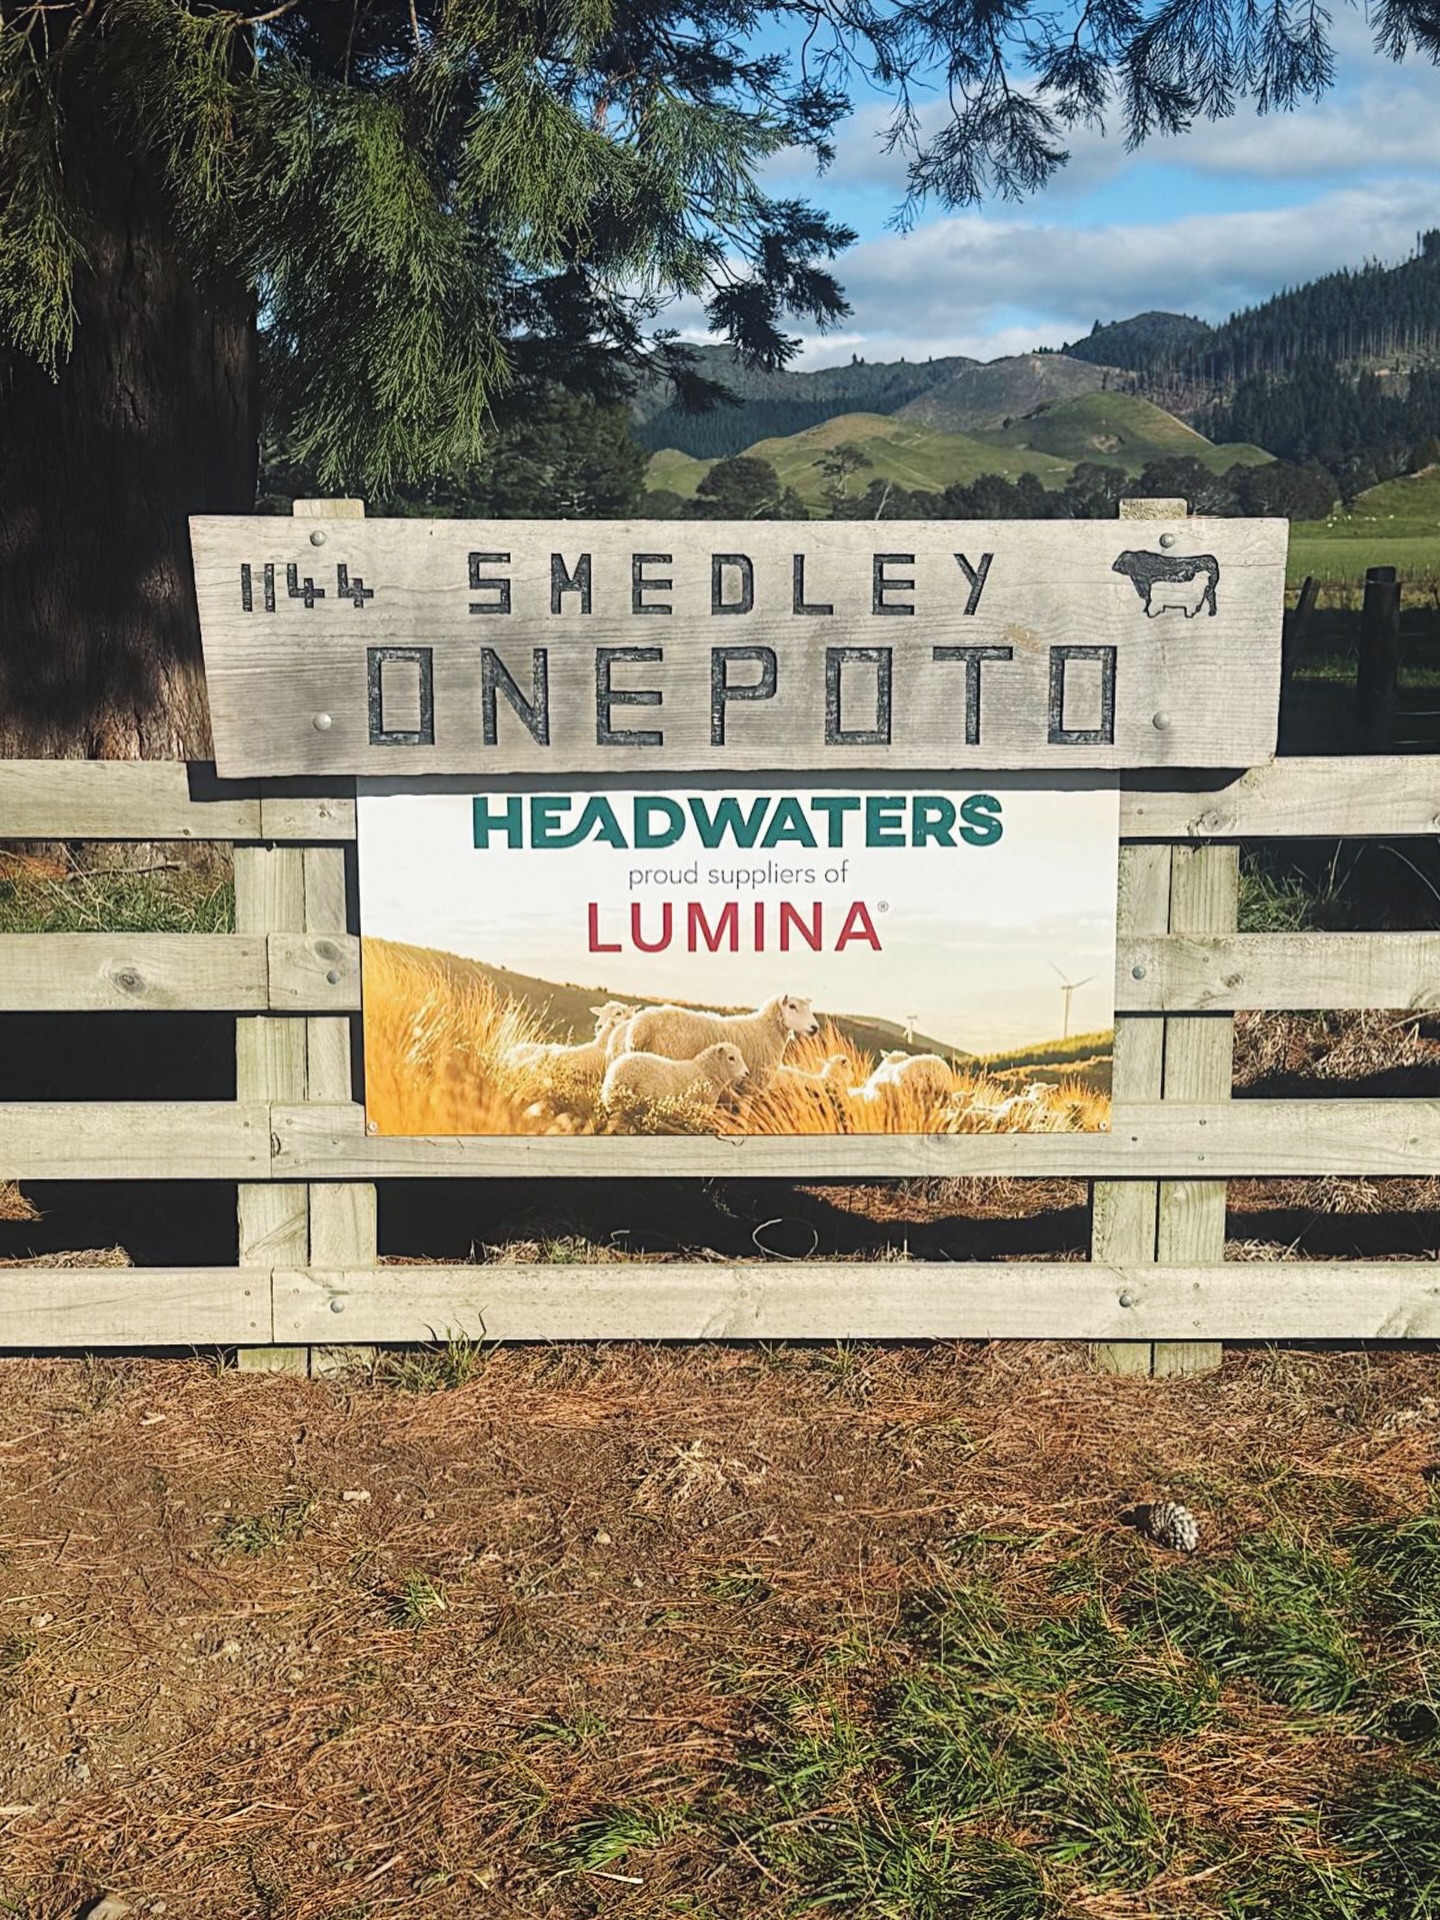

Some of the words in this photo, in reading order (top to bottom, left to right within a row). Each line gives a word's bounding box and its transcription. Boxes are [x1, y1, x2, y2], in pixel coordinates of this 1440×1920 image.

[240, 563, 374, 613] 1144
[468, 552, 995, 616] SMEDLEY
[367, 645, 1118, 747] ONEPOTO
[472, 794, 1004, 850] HEADWATERS
[628, 860, 699, 890] proud
[707, 859, 816, 890] suppliers
[823, 859, 850, 885] of
